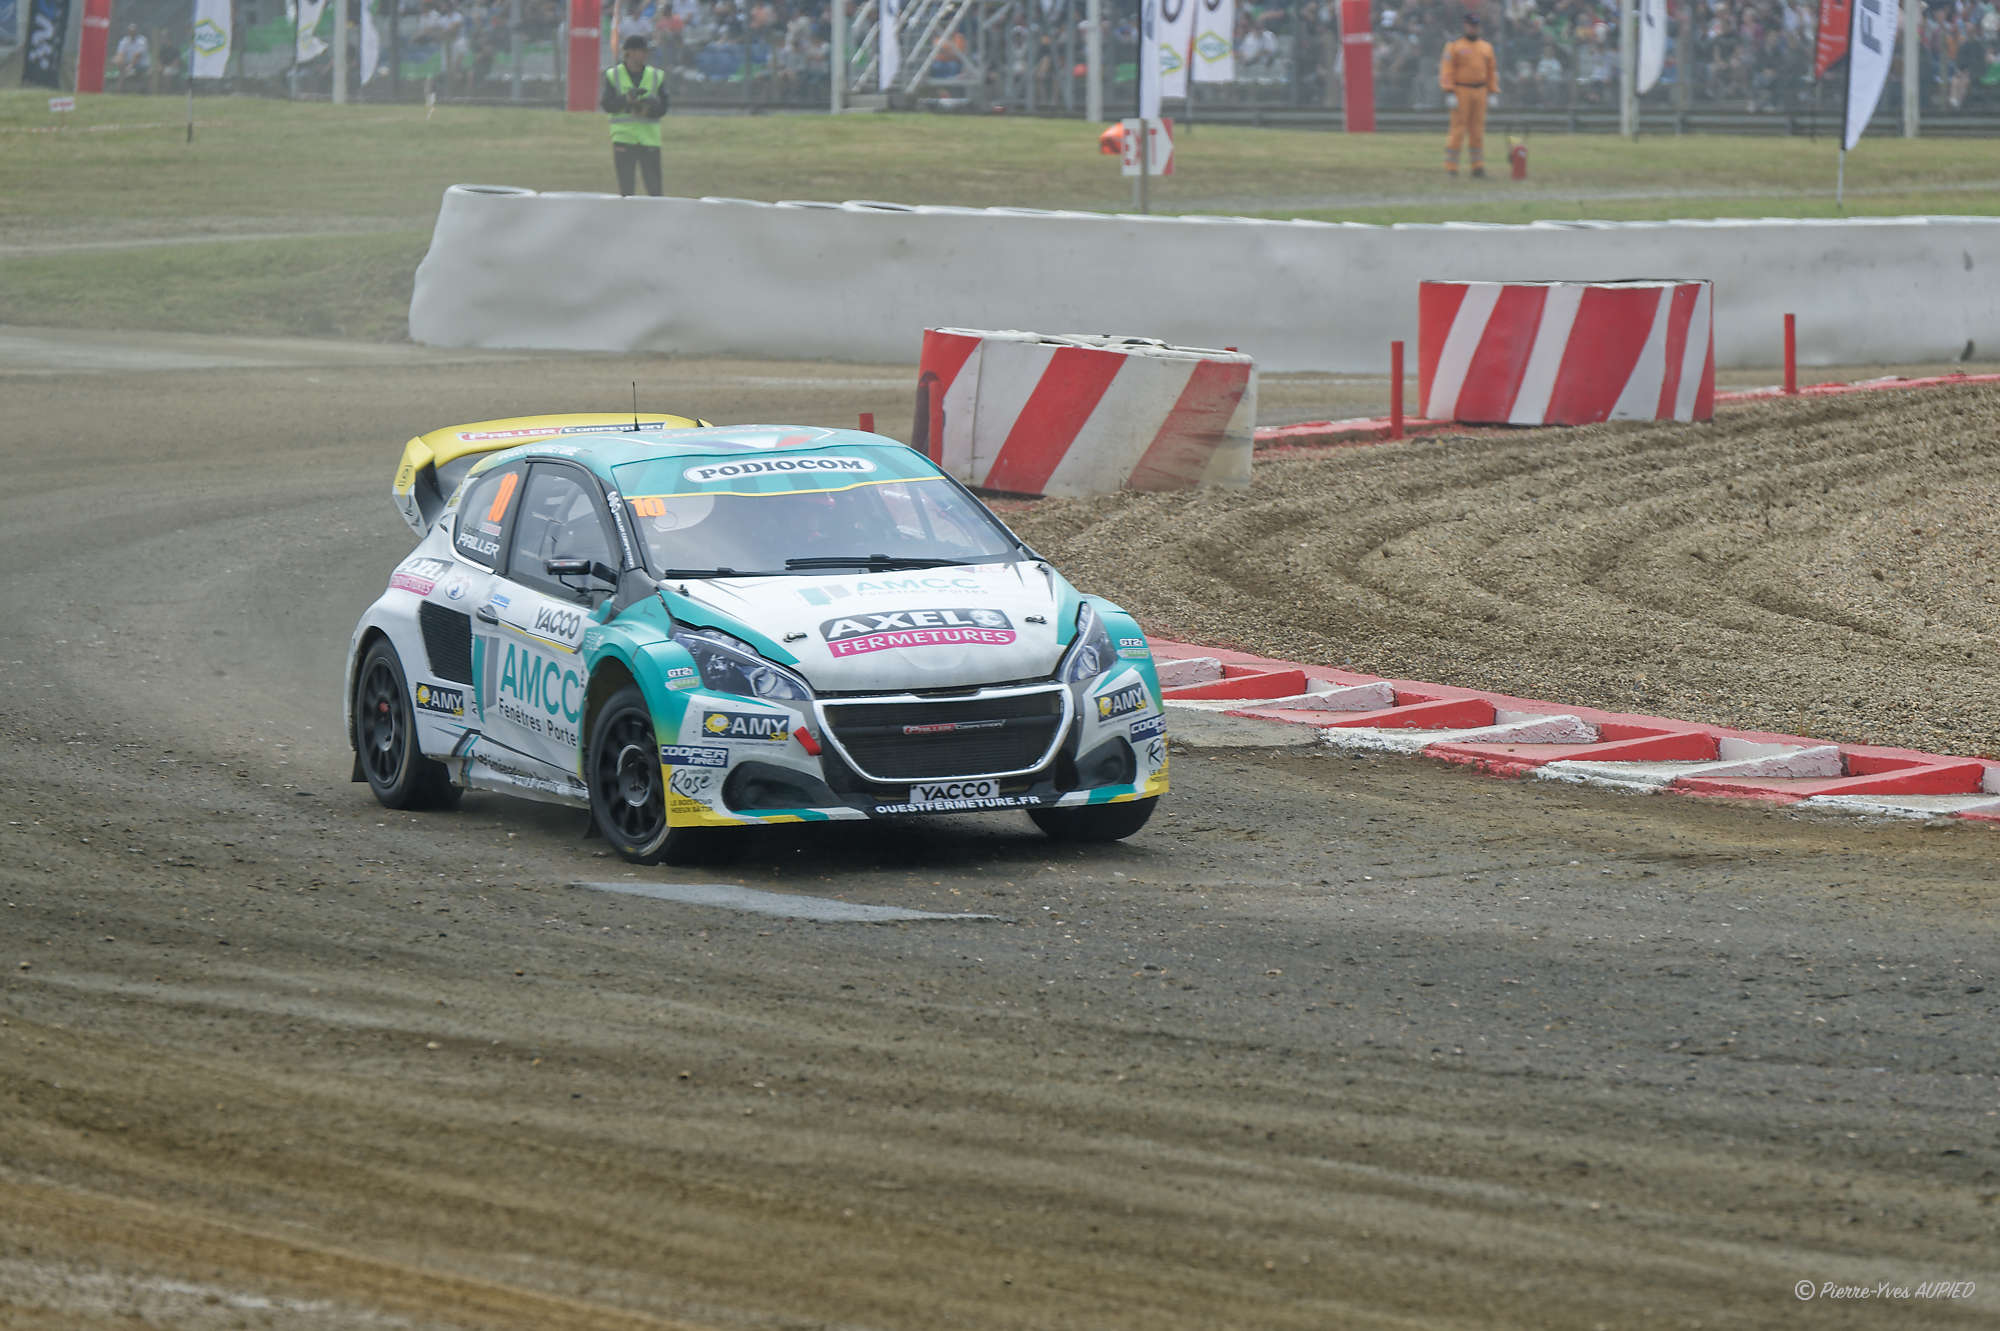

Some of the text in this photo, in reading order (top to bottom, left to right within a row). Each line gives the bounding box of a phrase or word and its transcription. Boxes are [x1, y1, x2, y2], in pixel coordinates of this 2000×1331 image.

[1123, 128, 1158, 167] EXT
[696, 459, 865, 480] PODIOCOM
[487, 472, 519, 523] 10
[631, 498, 667, 518] 10
[856, 578, 981, 592] AMCC
[534, 606, 581, 640] YACCO
[827, 609, 974, 639] AXEL
[837, 628, 1010, 654] FERMETURES
[500, 643, 579, 723] AMCC
[431, 690, 462, 711] AMY
[1113, 687, 1144, 713] AMY
[499, 697, 542, 733] Fenêtres
[731, 717, 788, 736] AMY
[661, 746, 727, 759] COOPER
[687, 756, 726, 766] TIRES
[668, 768, 713, 798] Rose
[920, 781, 991, 801] YACCO
[875, 795, 1041, 814] OUESTFERMETURE.FR
